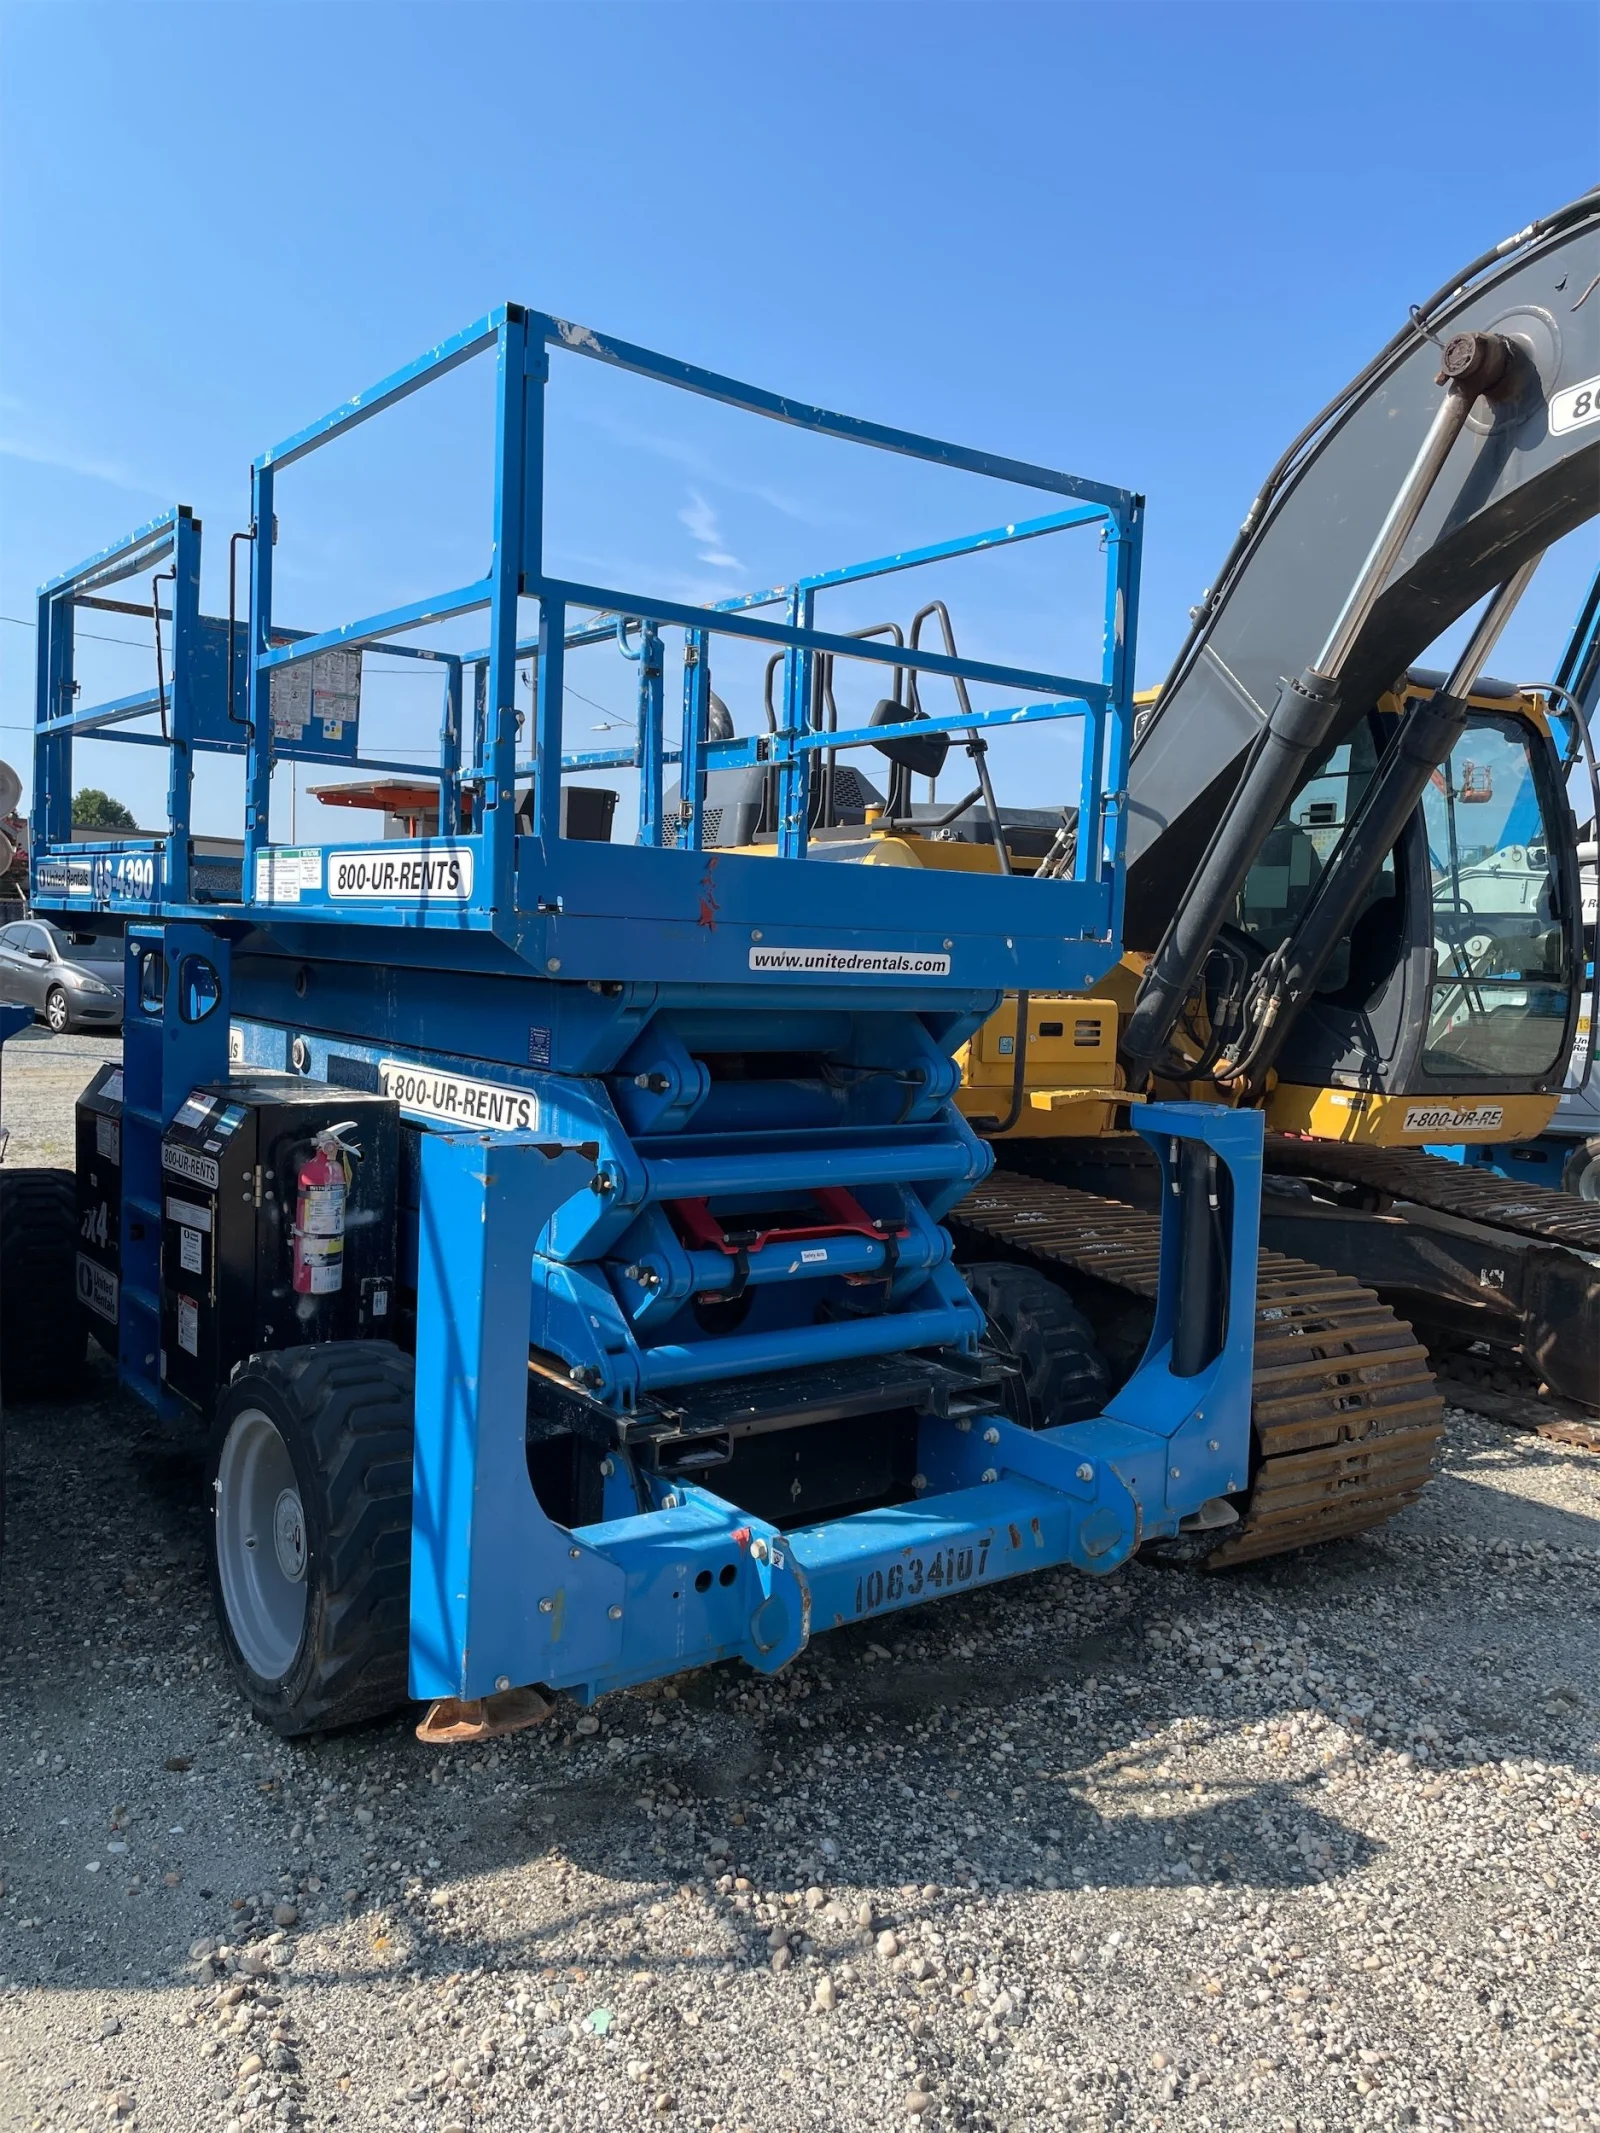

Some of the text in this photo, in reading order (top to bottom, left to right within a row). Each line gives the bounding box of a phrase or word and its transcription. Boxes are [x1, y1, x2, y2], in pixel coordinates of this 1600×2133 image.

[46, 867, 89, 888] United Rentals
[93, 859, 153, 899] GS-4390
[337, 859, 460, 891] 800-UR-RENTS
[754, 953, 946, 973] www.unitedrentals.com
[383, 1071, 531, 1128] 1-800-UR-RENTS
[164, 1148, 216, 1182] 800-UR-RENTS
[93, 1268, 114, 1296] United
[93, 1286, 115, 1316] Rentals
